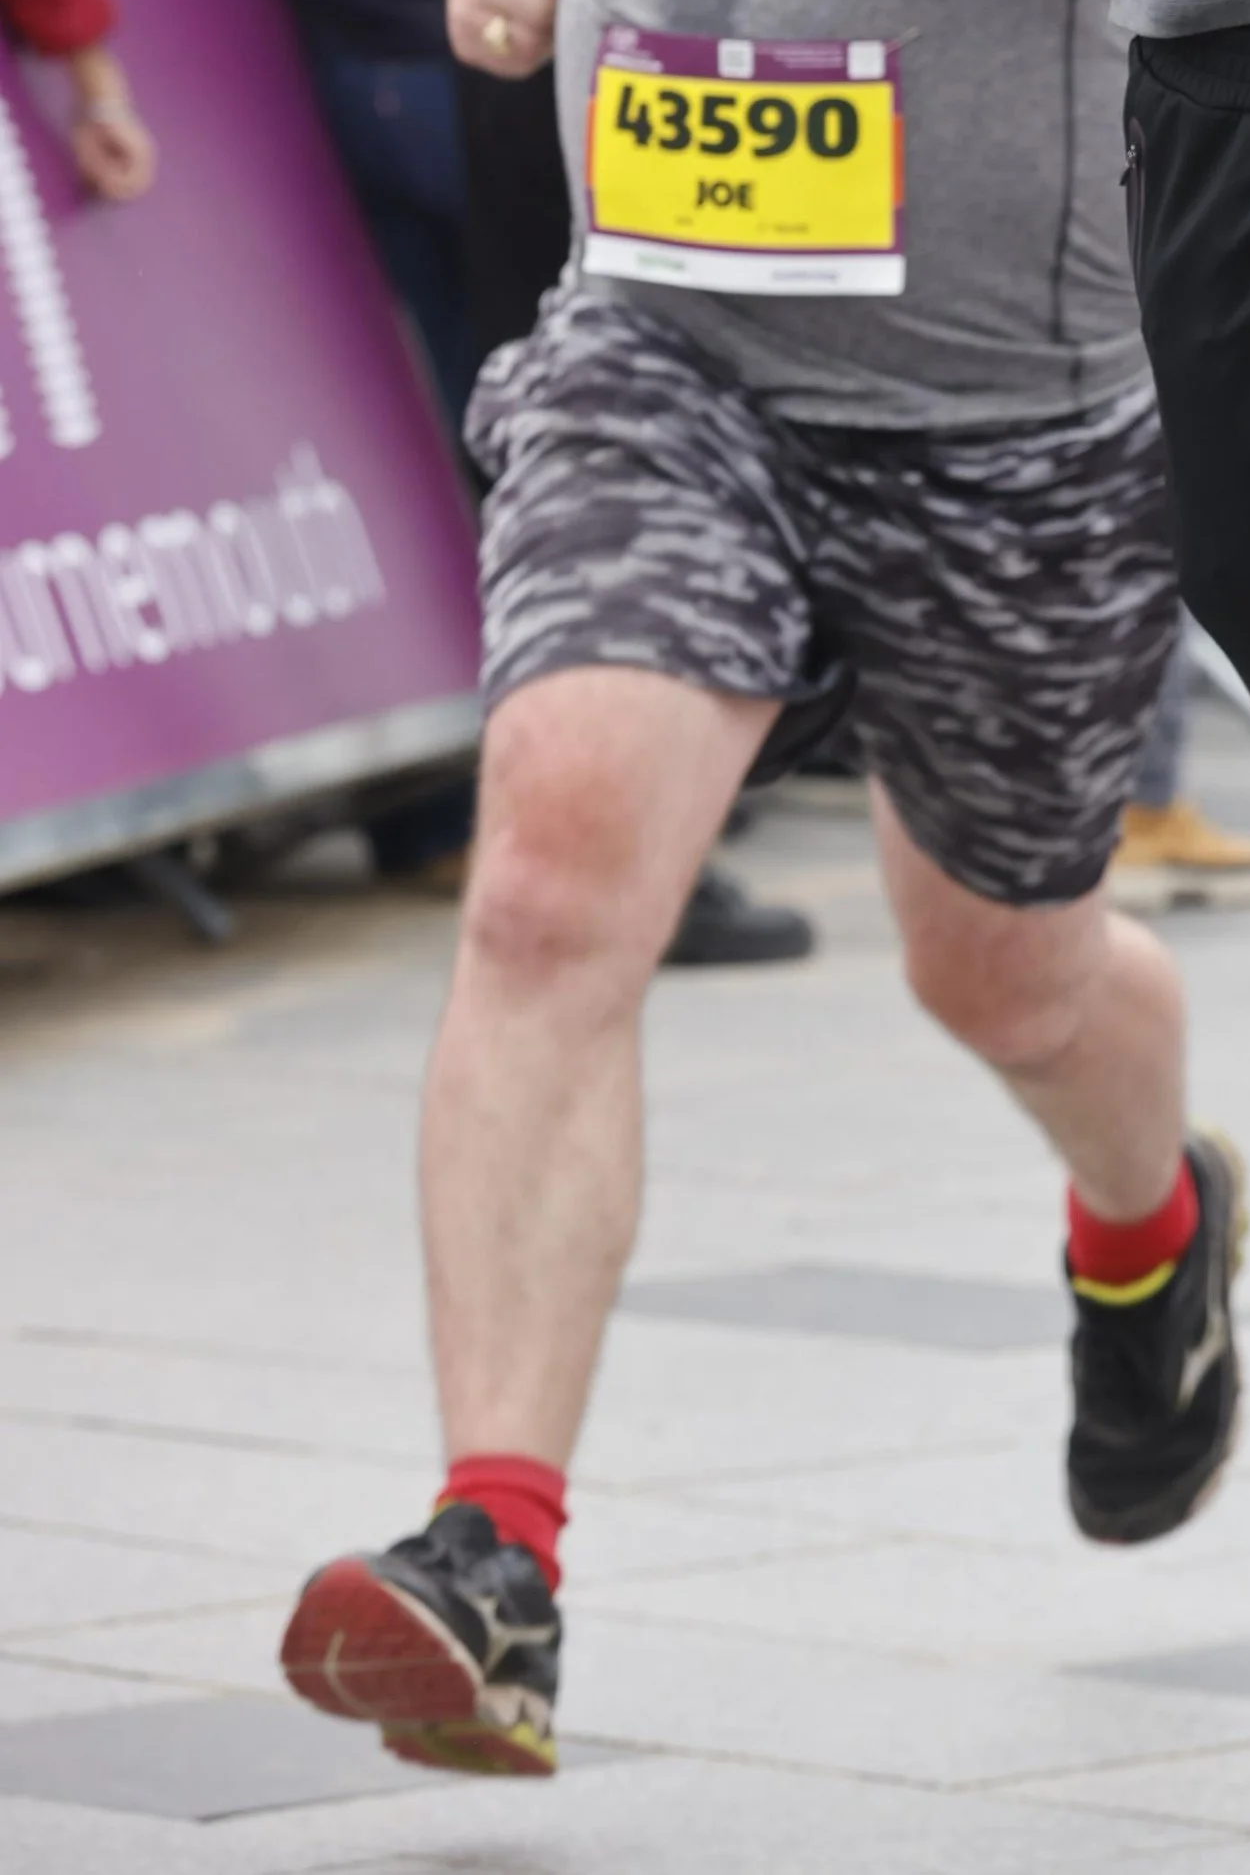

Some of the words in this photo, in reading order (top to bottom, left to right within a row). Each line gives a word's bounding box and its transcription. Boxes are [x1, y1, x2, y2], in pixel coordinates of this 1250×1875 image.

[614, 82, 861, 159] 43590
[695, 179, 756, 212] JOE
[0, 437, 387, 695] urnemouth
